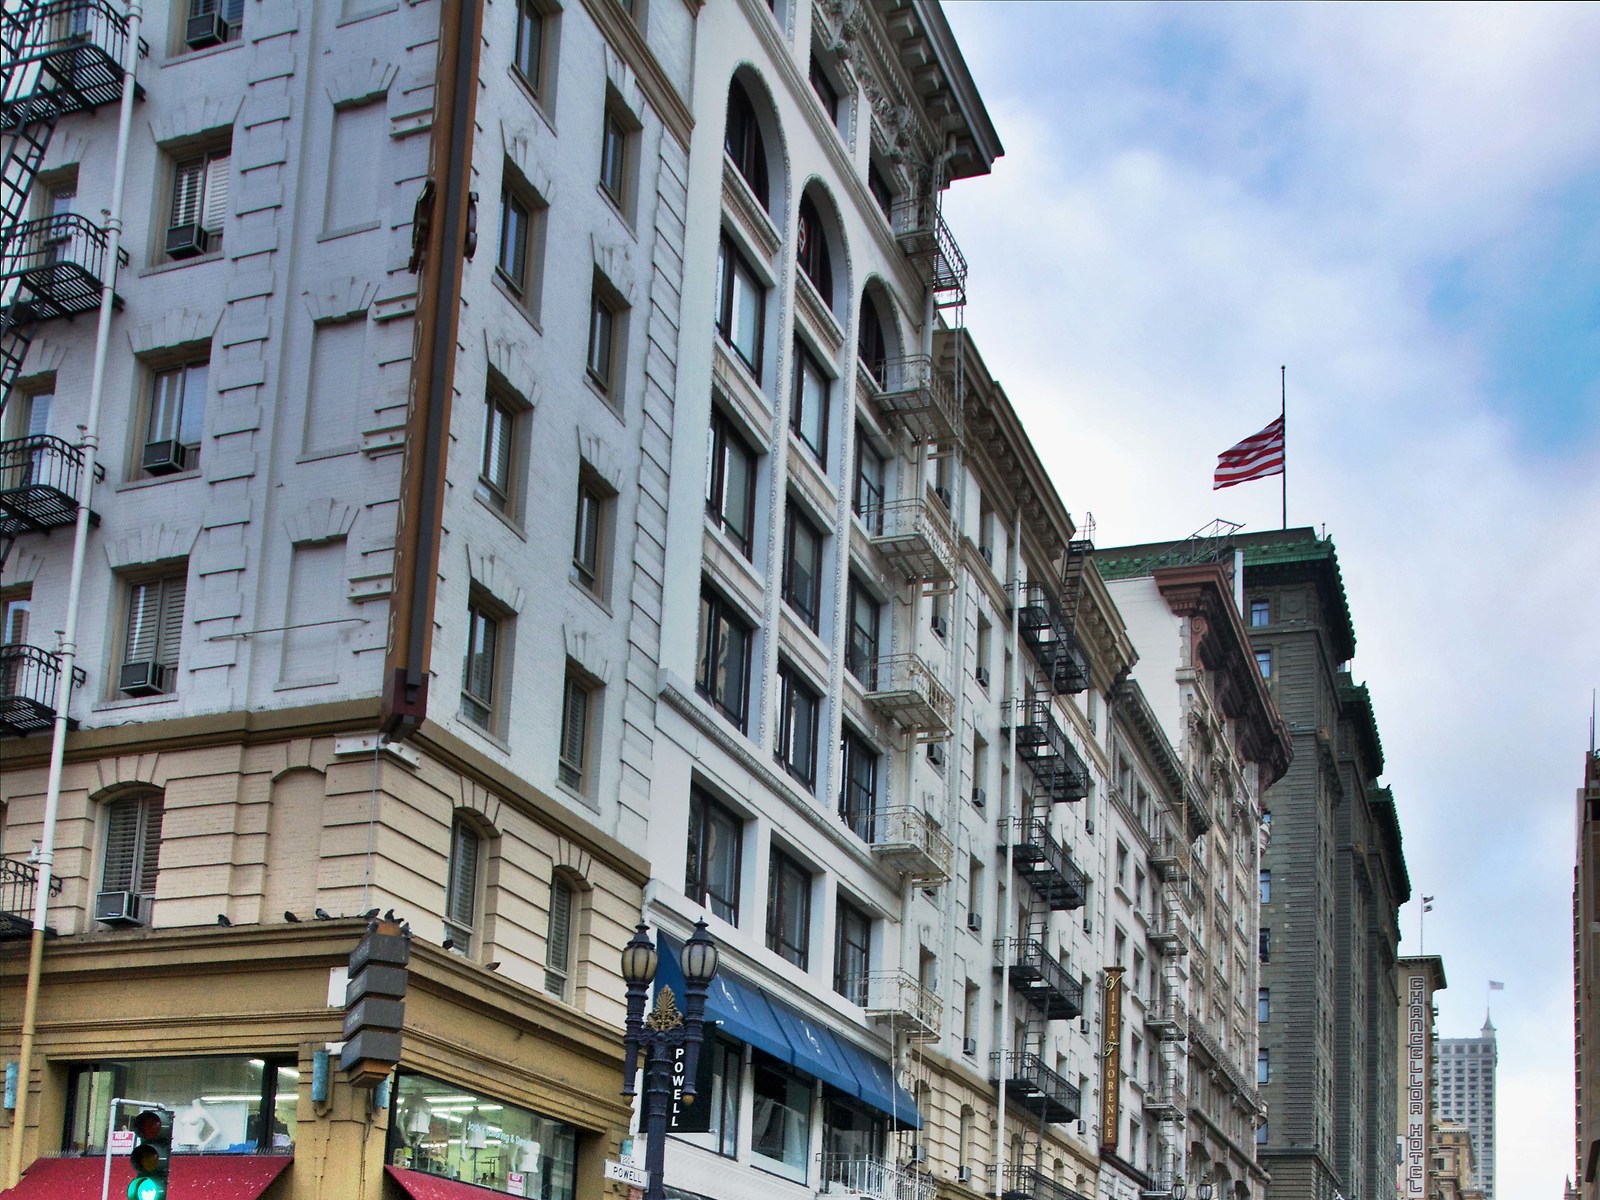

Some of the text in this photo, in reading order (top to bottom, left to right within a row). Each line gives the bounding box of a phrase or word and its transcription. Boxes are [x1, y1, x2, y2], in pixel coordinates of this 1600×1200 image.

[1105, 974, 1122, 1040] VILLA
[671, 1048, 685, 1127] POWELL
[1103, 1041, 1119, 1138] FLORENCE
[1409, 977, 1423, 1192] CHANCELLOR HOTEL
[613, 1166, 642, 1183] POWELL
